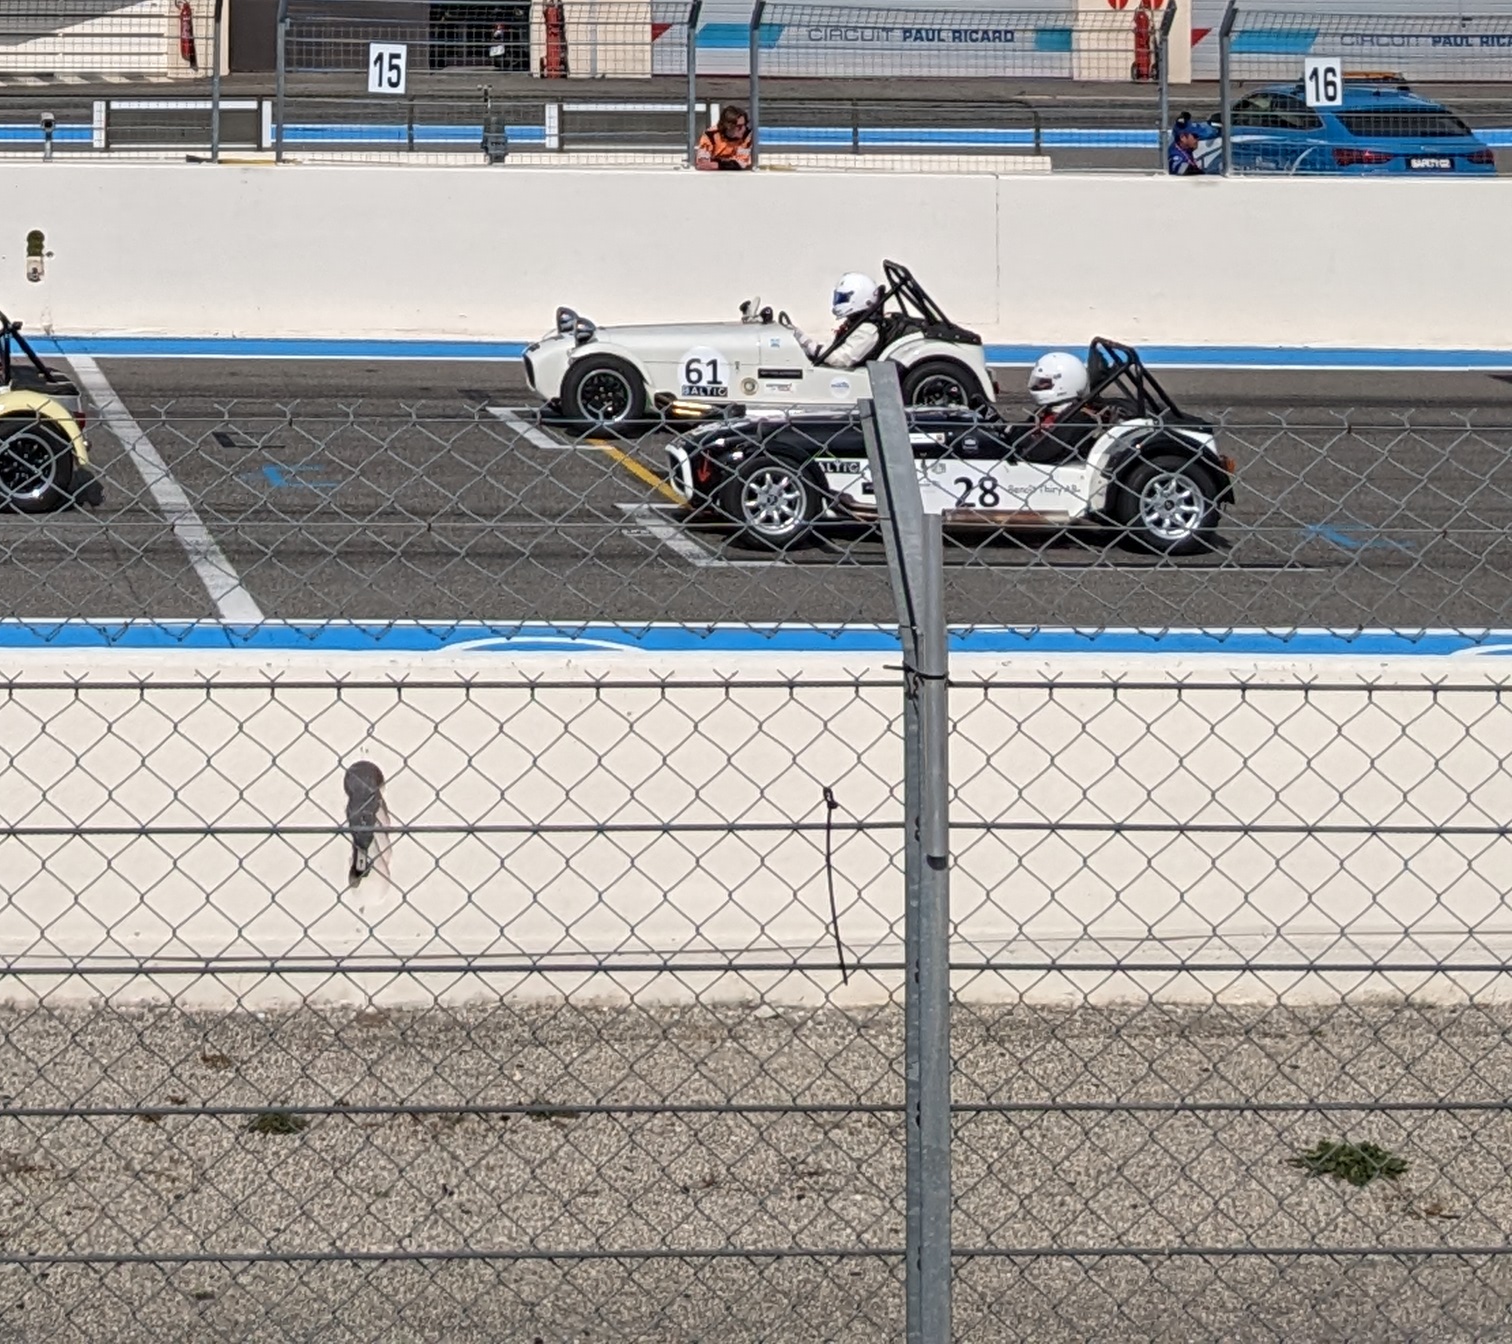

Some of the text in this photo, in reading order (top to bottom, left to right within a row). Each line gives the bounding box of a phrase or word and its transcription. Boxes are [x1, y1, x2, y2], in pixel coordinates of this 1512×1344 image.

[808, 28, 1015, 43] CIRCUIT PAUL RICARD
[1431, 35, 1473, 48] PAUL
[374, 52, 401, 88] 15
[1308, 67, 1338, 102] 16
[685, 358, 723, 385] 61
[682, 385, 727, 397] BALTIC
[954, 476, 1000, 508] 28
